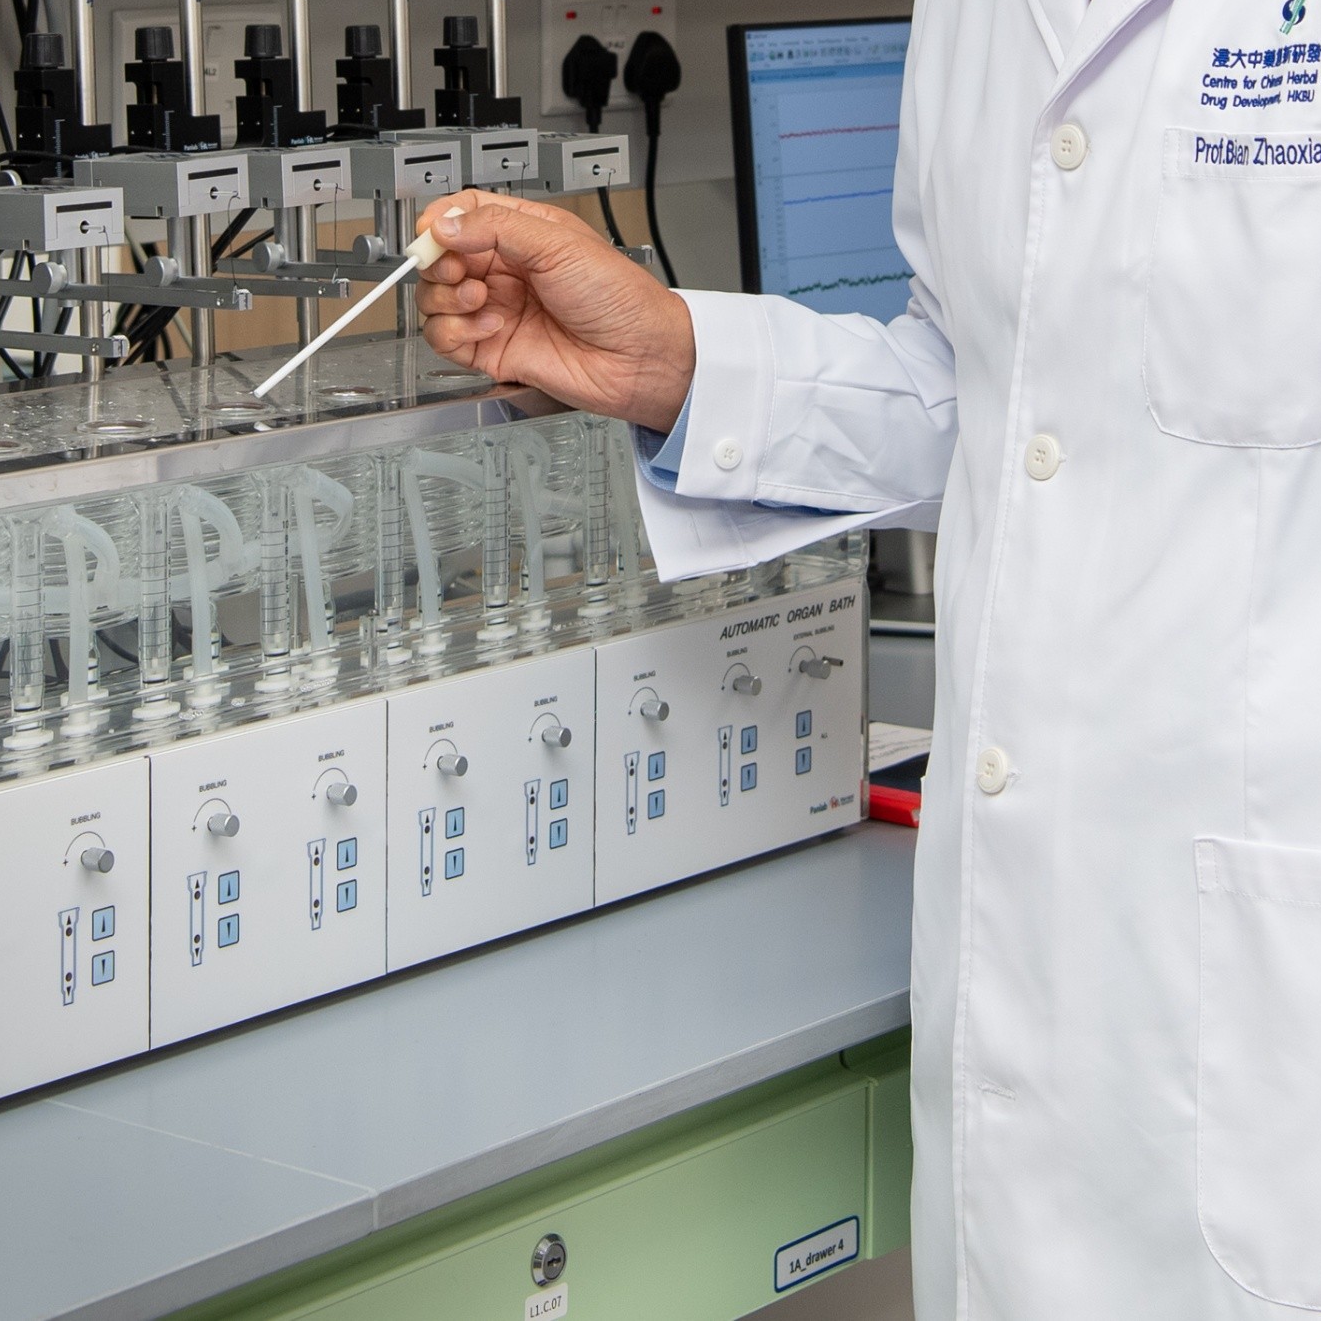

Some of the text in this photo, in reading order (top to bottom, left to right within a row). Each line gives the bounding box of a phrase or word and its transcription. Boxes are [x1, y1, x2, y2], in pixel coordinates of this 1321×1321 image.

[1202, 74, 1238, 90] Centre
[1242, 75, 1256, 90] for
[1287, 70, 1318, 85] Herbal
[1200, 92, 1228, 110] Drug
[1287, 89, 1315, 102] HKBU
[1194, 136, 1250, 166] Prof.Bian
[720, 594, 856, 640] AUTOMATIC ORGAN BATH
[534, 696, 558, 708] BUBBLING
[428, 721, 454, 734] BUBBLING
[318, 749, 345, 763] BUBBLING
[198, 780, 228, 793] BUBBLING
[70, 812, 101, 826] BUBBLING
[789, 1238, 844, 1274] 1A_drawer 4
[530, 1295, 562, 1318] L1.C.07
